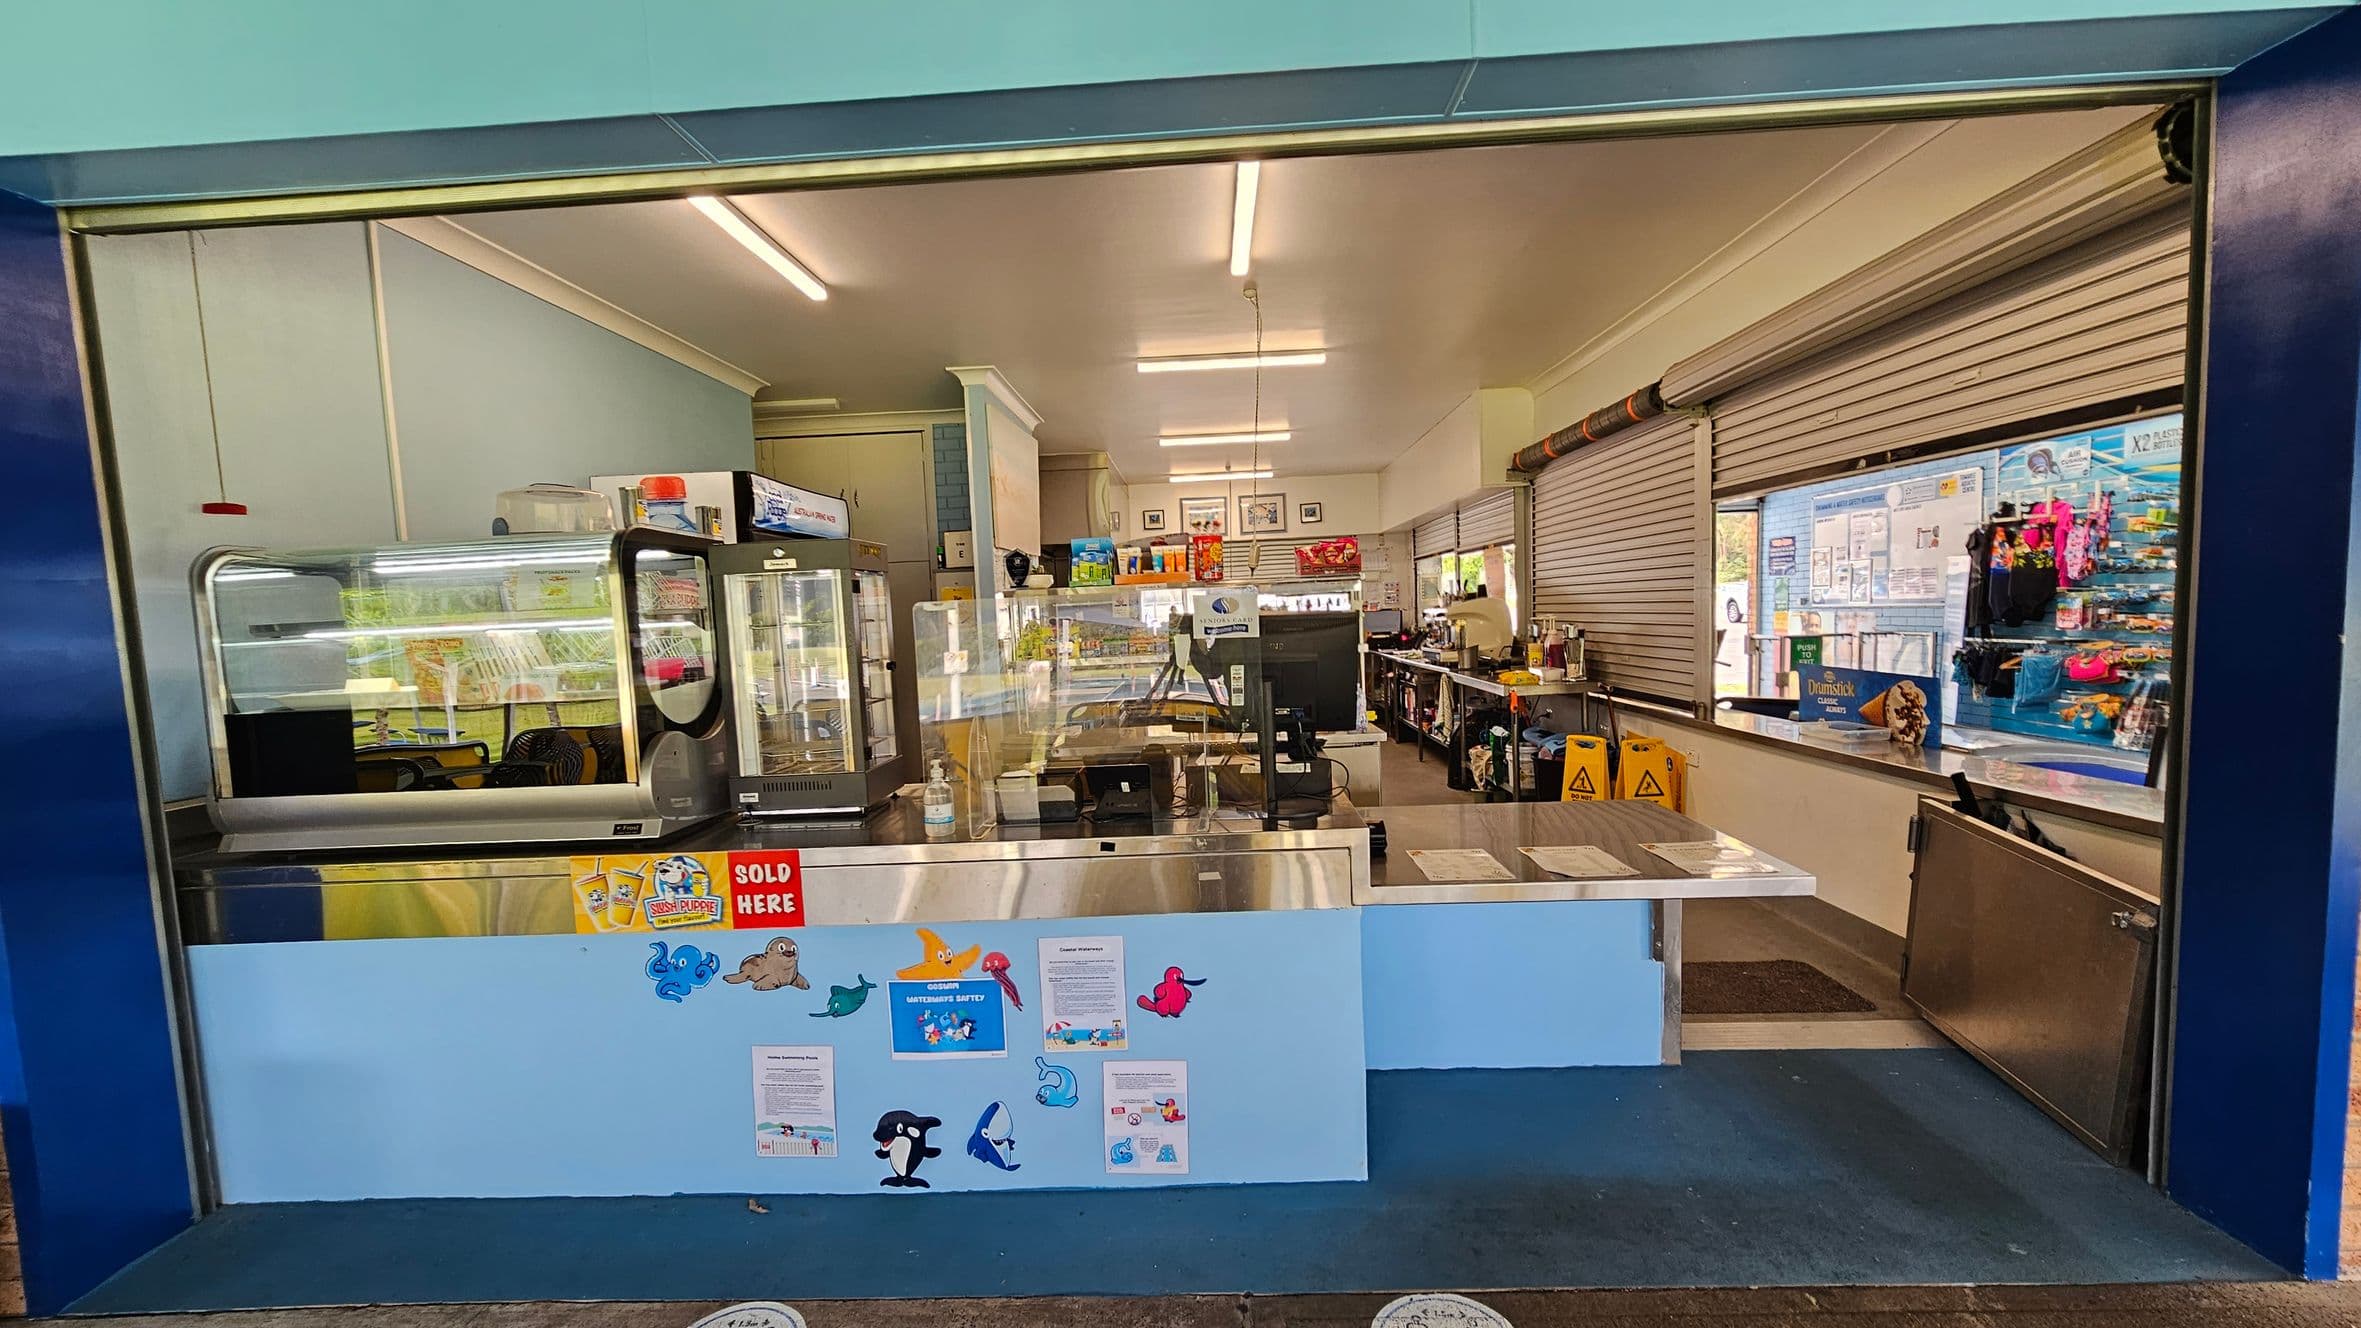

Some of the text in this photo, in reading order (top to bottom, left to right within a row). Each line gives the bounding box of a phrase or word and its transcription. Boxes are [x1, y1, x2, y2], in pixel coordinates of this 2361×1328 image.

[2131, 434, 2151, 453] X2
[2061, 457, 2088, 465] CUSHION
[1808, 679, 1855, 697] Drumstick
[1817, 697, 1839, 706] CLASSIC
[735, 863, 792, 885] SOLD
[649, 900, 678, 916] SLUSH
[680, 899, 717, 914] PUPPIE
[737, 892, 797, 915] HERE
[906, 995, 954, 1004] WATERWAYS
